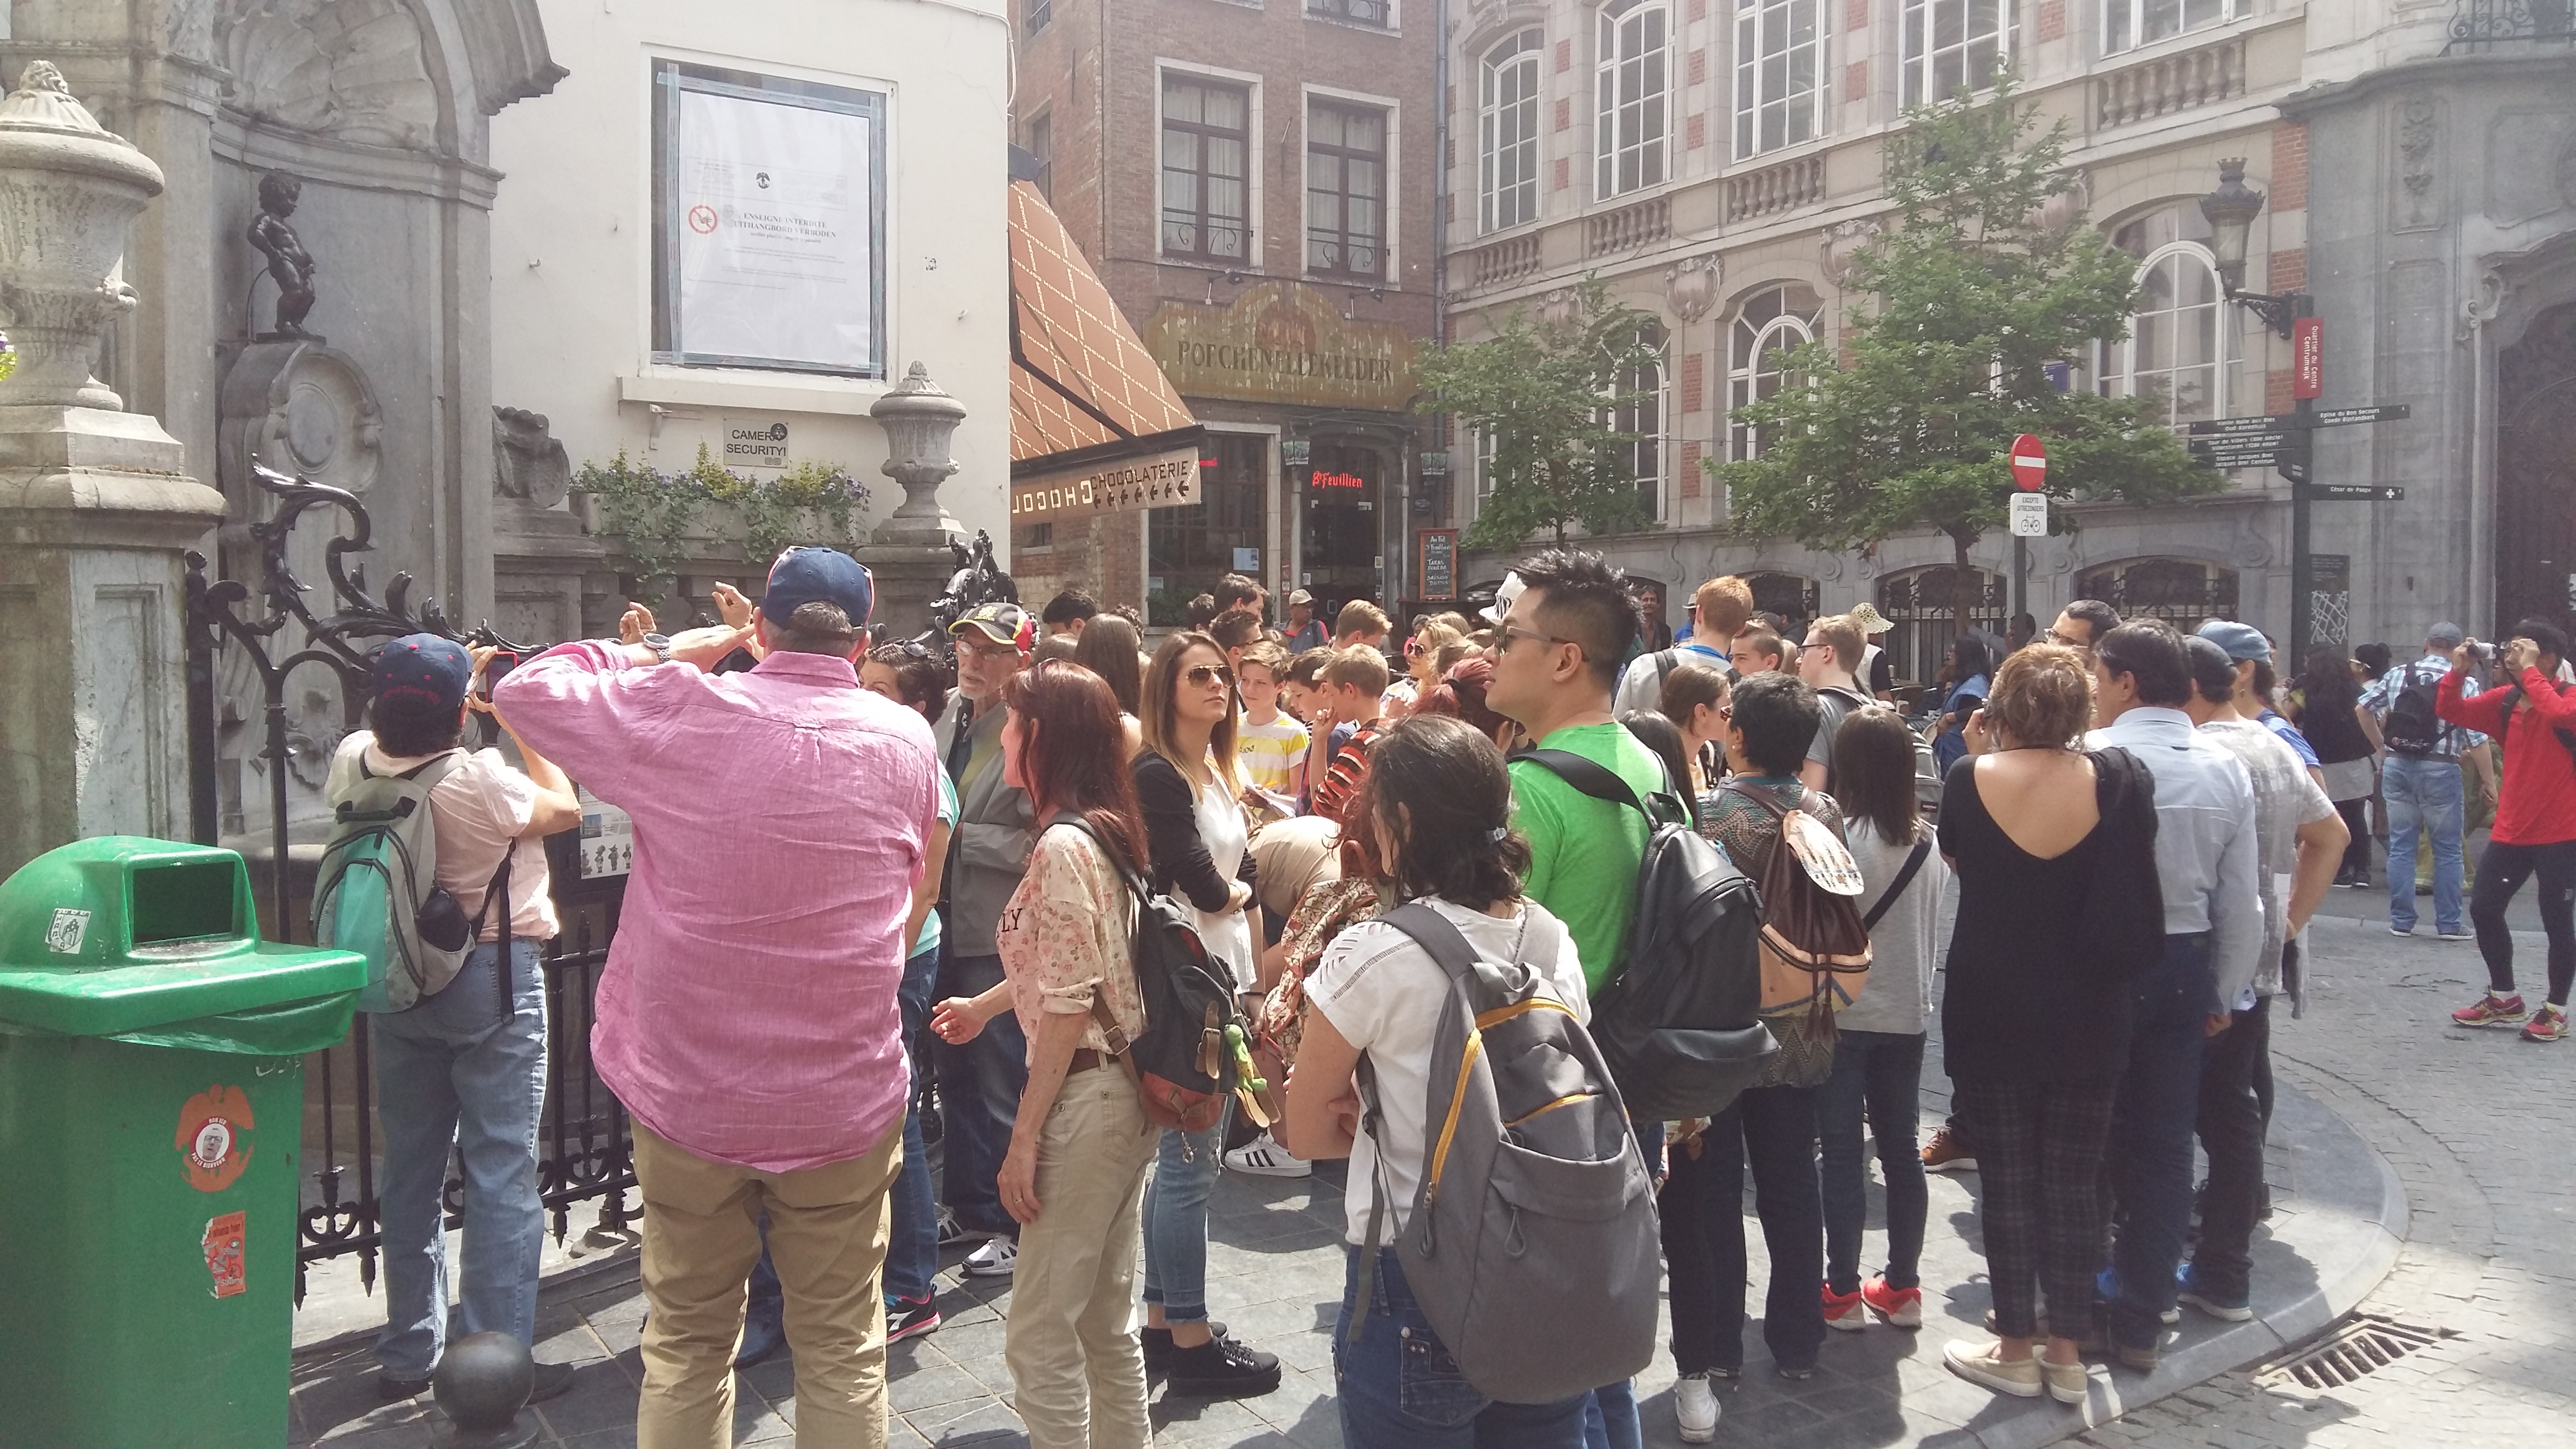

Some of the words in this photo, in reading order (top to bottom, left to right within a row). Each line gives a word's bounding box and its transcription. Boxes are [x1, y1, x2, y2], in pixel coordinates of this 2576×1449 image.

[2311, 355, 2318, 364] du
[732, 429, 776, 441] CAMER
[726, 443, 786, 456] SECURITY!
[1090, 461, 1188, 490] CHOCOLATERIE
[1000, 907, 1023, 934] LY
